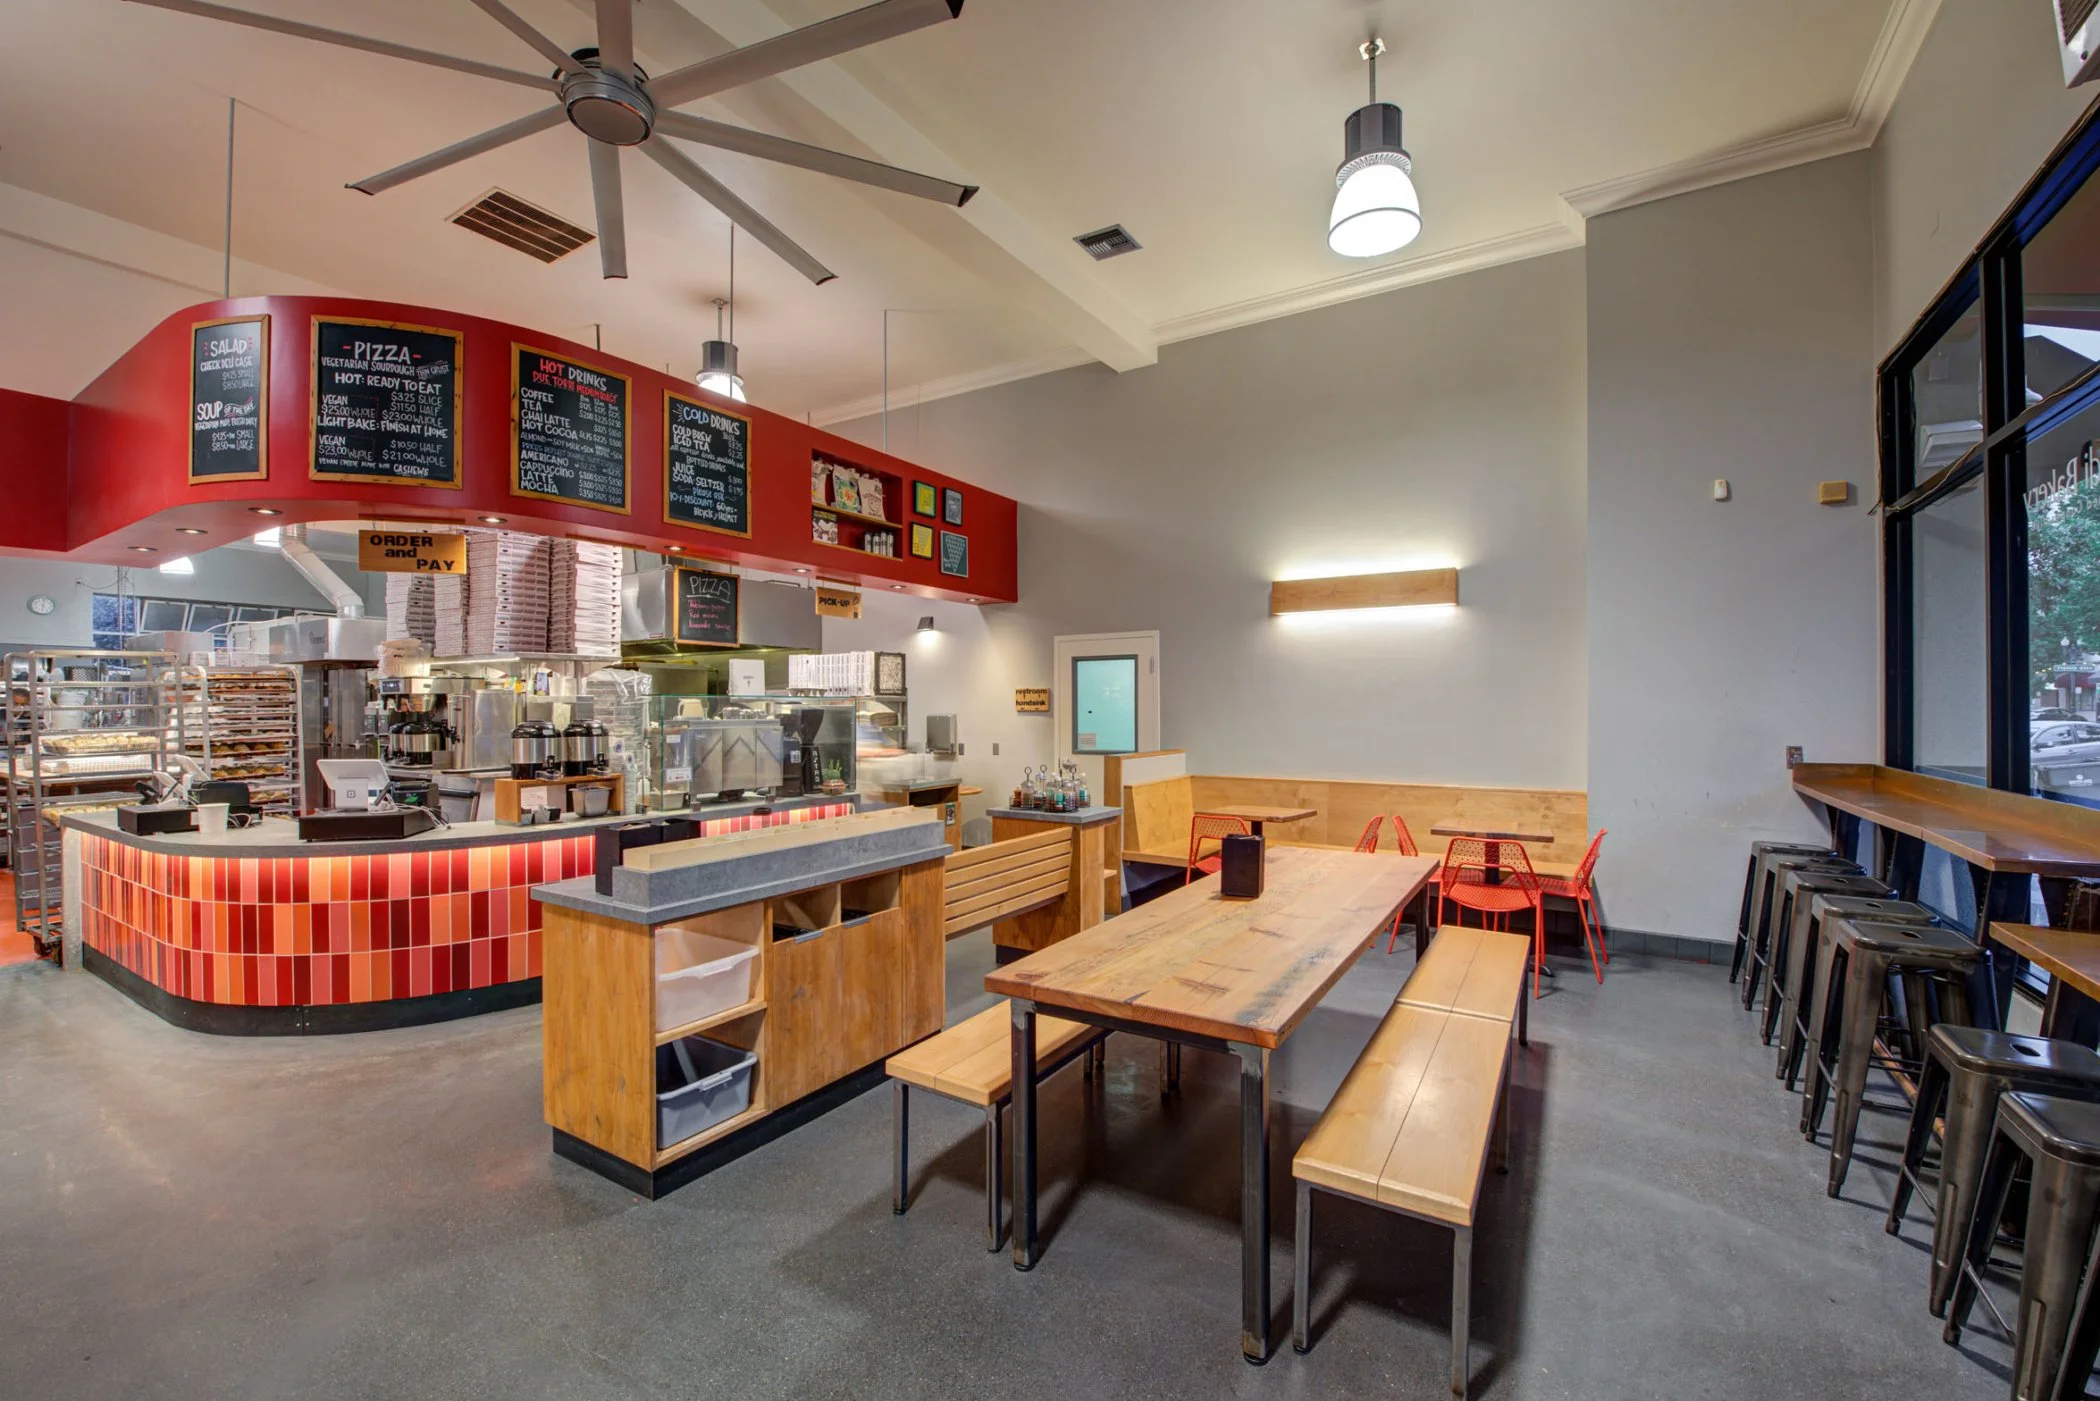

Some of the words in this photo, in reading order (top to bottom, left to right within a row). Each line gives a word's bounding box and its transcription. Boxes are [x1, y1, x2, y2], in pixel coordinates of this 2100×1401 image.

[210, 338, 247, 357] SALAD
[354, 341, 411, 365] PIZZA
[200, 359, 221, 372] CHECK
[235, 355, 253, 368] CASE
[321, 356, 369, 370] VEGETARIAN
[371, 361, 415, 377] SOURDOUGH
[532, 371, 550, 385] DUE
[540, 358, 565, 376] HOT
[568, 367, 607, 391] DRINKS
[335, 372, 365, 385] HOT:
[366, 375, 400, 390] READY
[402, 379, 418, 391] TO
[418, 381, 443, 396] EAT
[322, 394, 348, 406] VEGAN
[418, 395, 443, 407] SLICE
[520, 387, 555, 404] COFFEE
[197, 400, 223, 420] SOUP
[419, 404, 441, 416] HALF
[521, 398, 543, 412] TEA
[350, 407, 375, 418] WHOLE
[521, 409, 543, 423] CHAI
[544, 413, 571, 429] LATTE
[317, 414, 347, 427] LIGHT
[347, 417, 380, 430] BAKE:
[381, 420, 410, 433] FINISH
[410, 424, 422, 434] AT
[423, 426, 449, 439] HOME
[412, 414, 443, 428] WHOLE
[683, 406, 709, 425] COLD
[710, 414, 741, 436] DRINKS
[236, 429, 254, 440] SMALL
[522, 418, 544, 432] HOT
[544, 425, 578, 441] COCOA
[672, 424, 692, 437] COLD
[691, 428, 712, 444] BREW
[318, 433, 346, 446] VEGAN
[520, 431, 547, 443] ALMOND
[673, 434, 692, 447] ICED
[693, 439, 711, 453] TEA
[347, 448, 373, 461] WHOLE
[419, 442, 443, 454] HALF
[415, 454, 447, 468] WHOLE
[520, 449, 569, 467] AMERICANO
[393, 463, 430, 477] CASHEWS
[672, 461, 695, 475] JUICE
[521, 470, 554, 484] LATTE
[520, 480, 559, 496] MOCHA
[695, 476, 725, 493] SELTZER
[370, 534, 434, 547] ORDER
[384, 547, 418, 558] and
[416, 559, 456, 571] PAY
[689, 575, 731, 600] PIZZA
